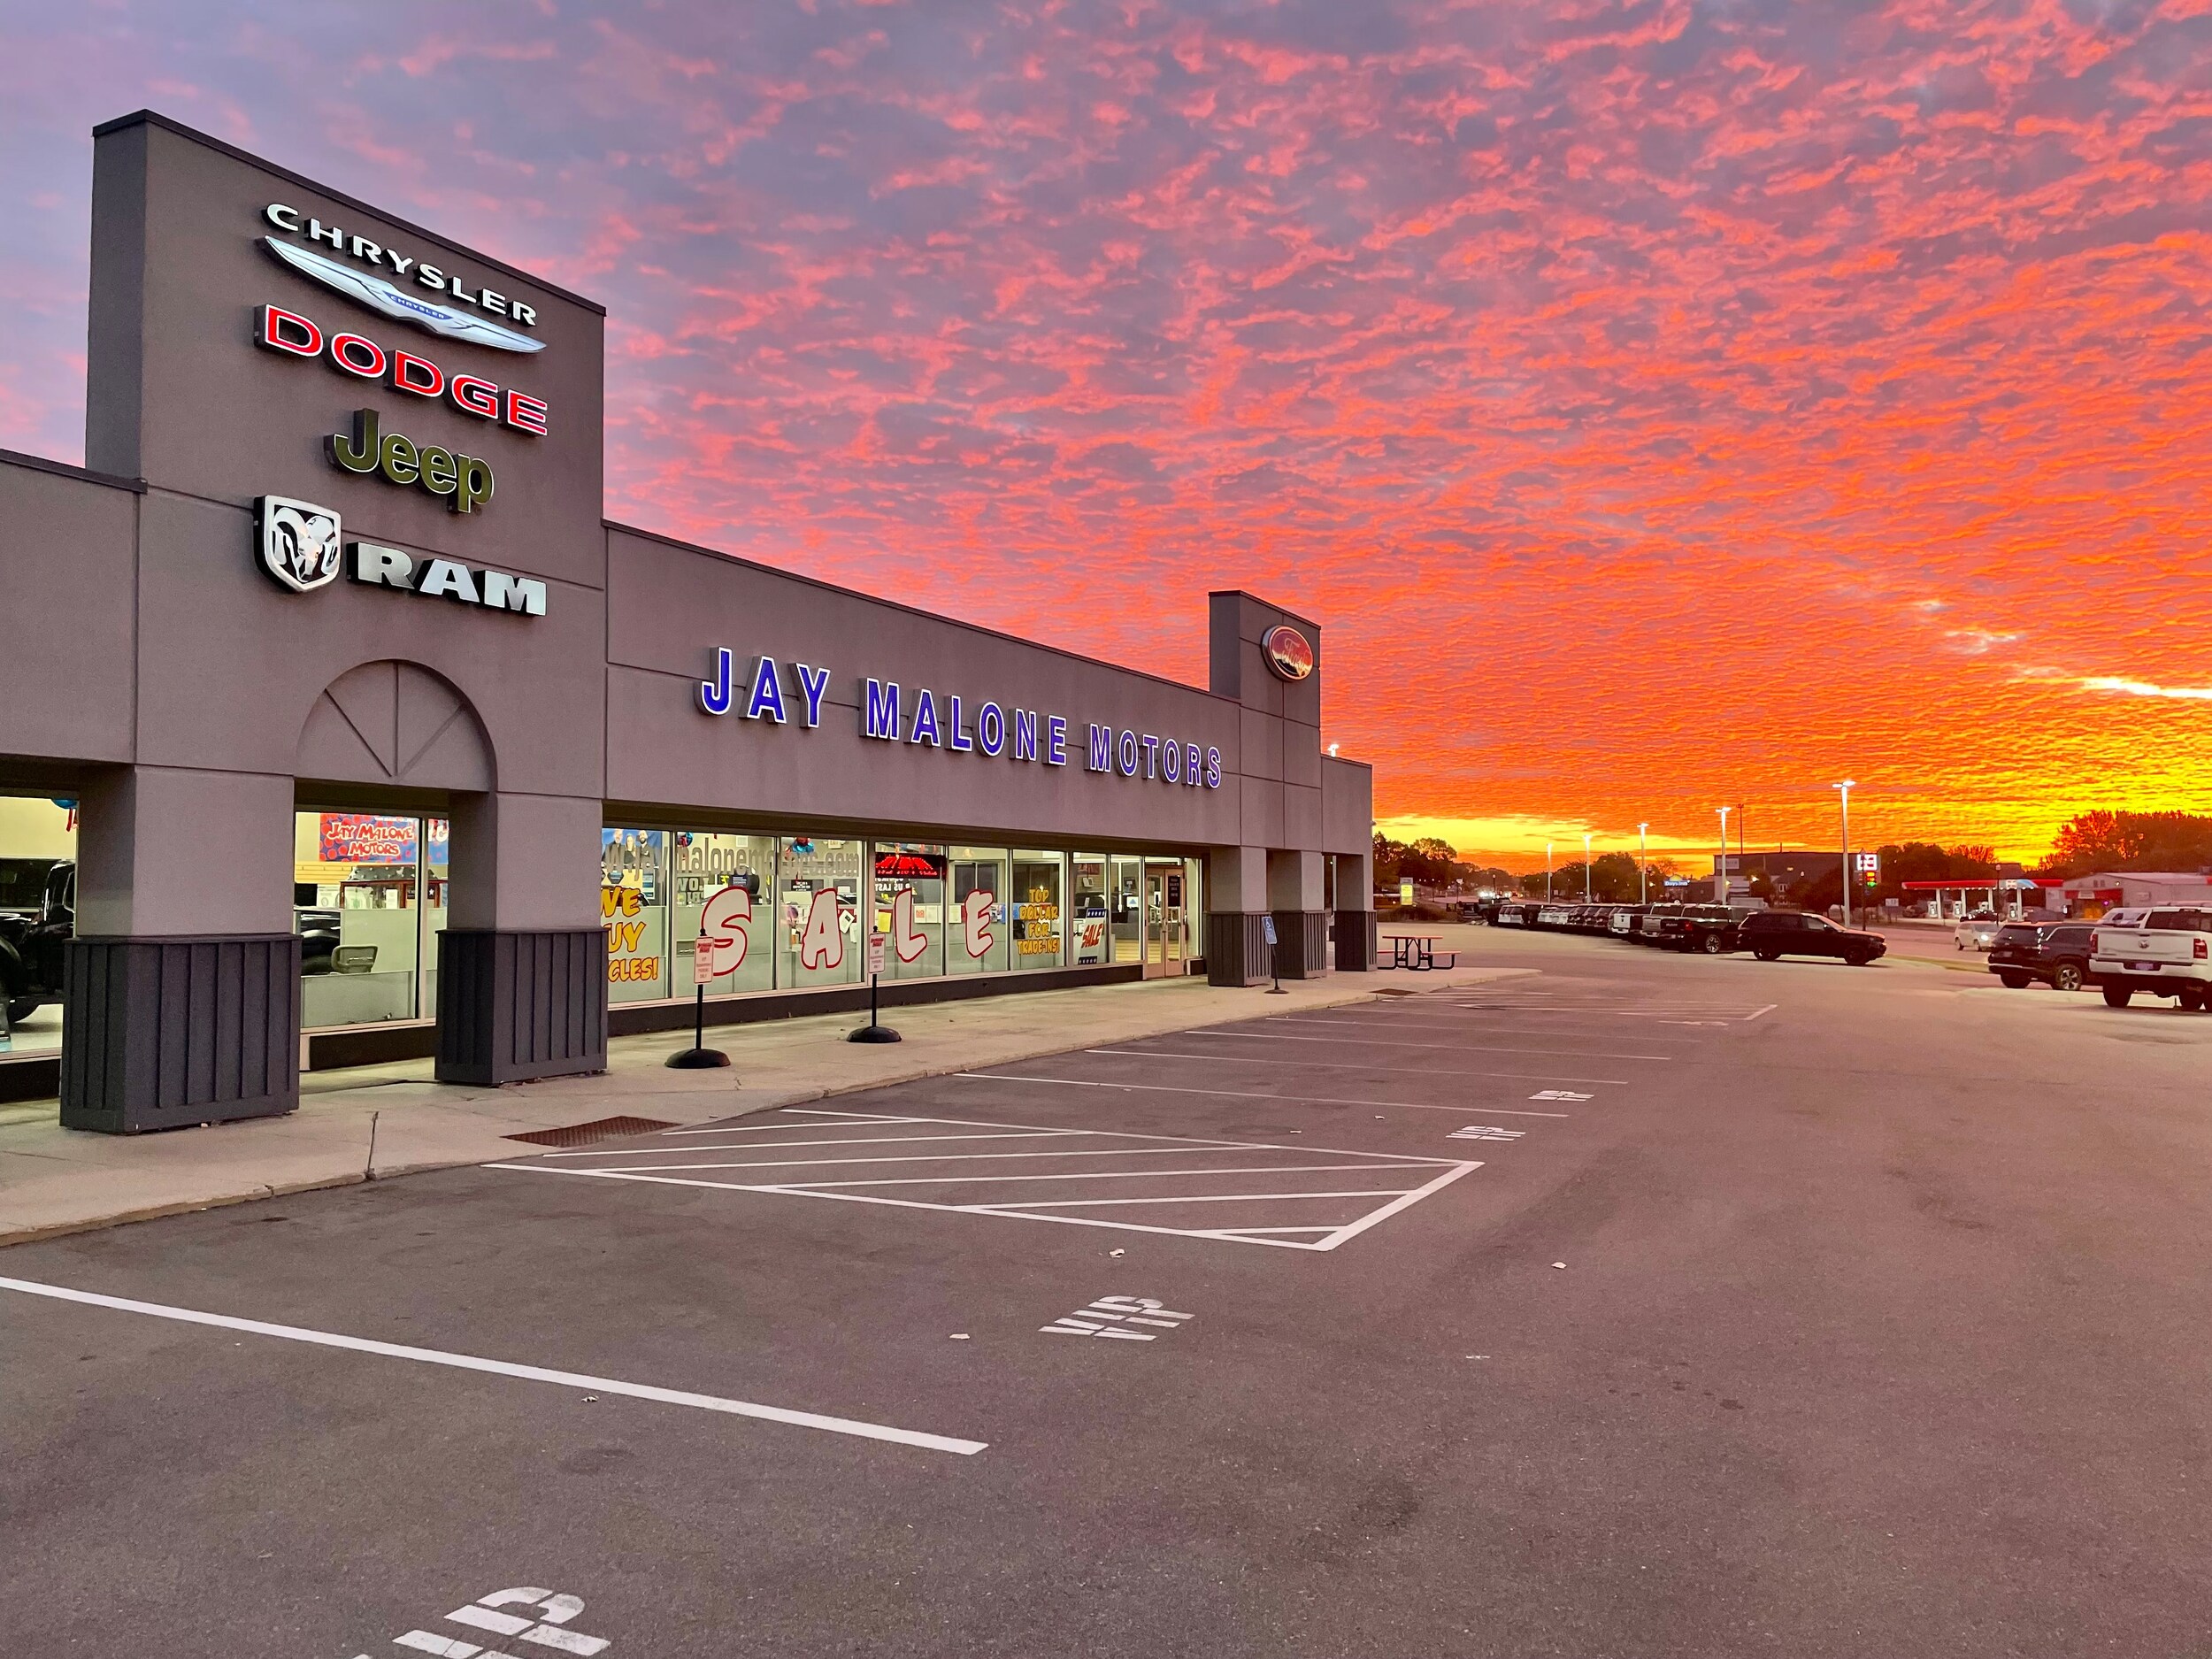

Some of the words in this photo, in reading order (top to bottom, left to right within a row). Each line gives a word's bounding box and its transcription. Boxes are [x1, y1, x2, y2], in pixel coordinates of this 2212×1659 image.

[265, 204, 537, 326] CHRYSLER
[264, 303, 548, 436] DODGE
[331, 408, 495, 513] Jeep
[354, 541, 547, 616] RAM
[700, 647, 830, 729] JAY
[864, 677, 1067, 766] MALONE
[1087, 723, 1222, 789] MOTORS
[326, 822, 356, 840] JAY
[356, 823, 415, 841] MALONE
[348, 841, 401, 856] MOTORS
[1029, 889, 1049, 903] TOP
[1018, 904, 1059, 920] DOLLAR
[603, 921, 647, 953] UY
[1027, 922, 1051, 938] FOR
[1080, 923, 1103, 949] SALE
[607, 956, 659, 983] CLES!
[1037, 1294, 1196, 1341] VIP
